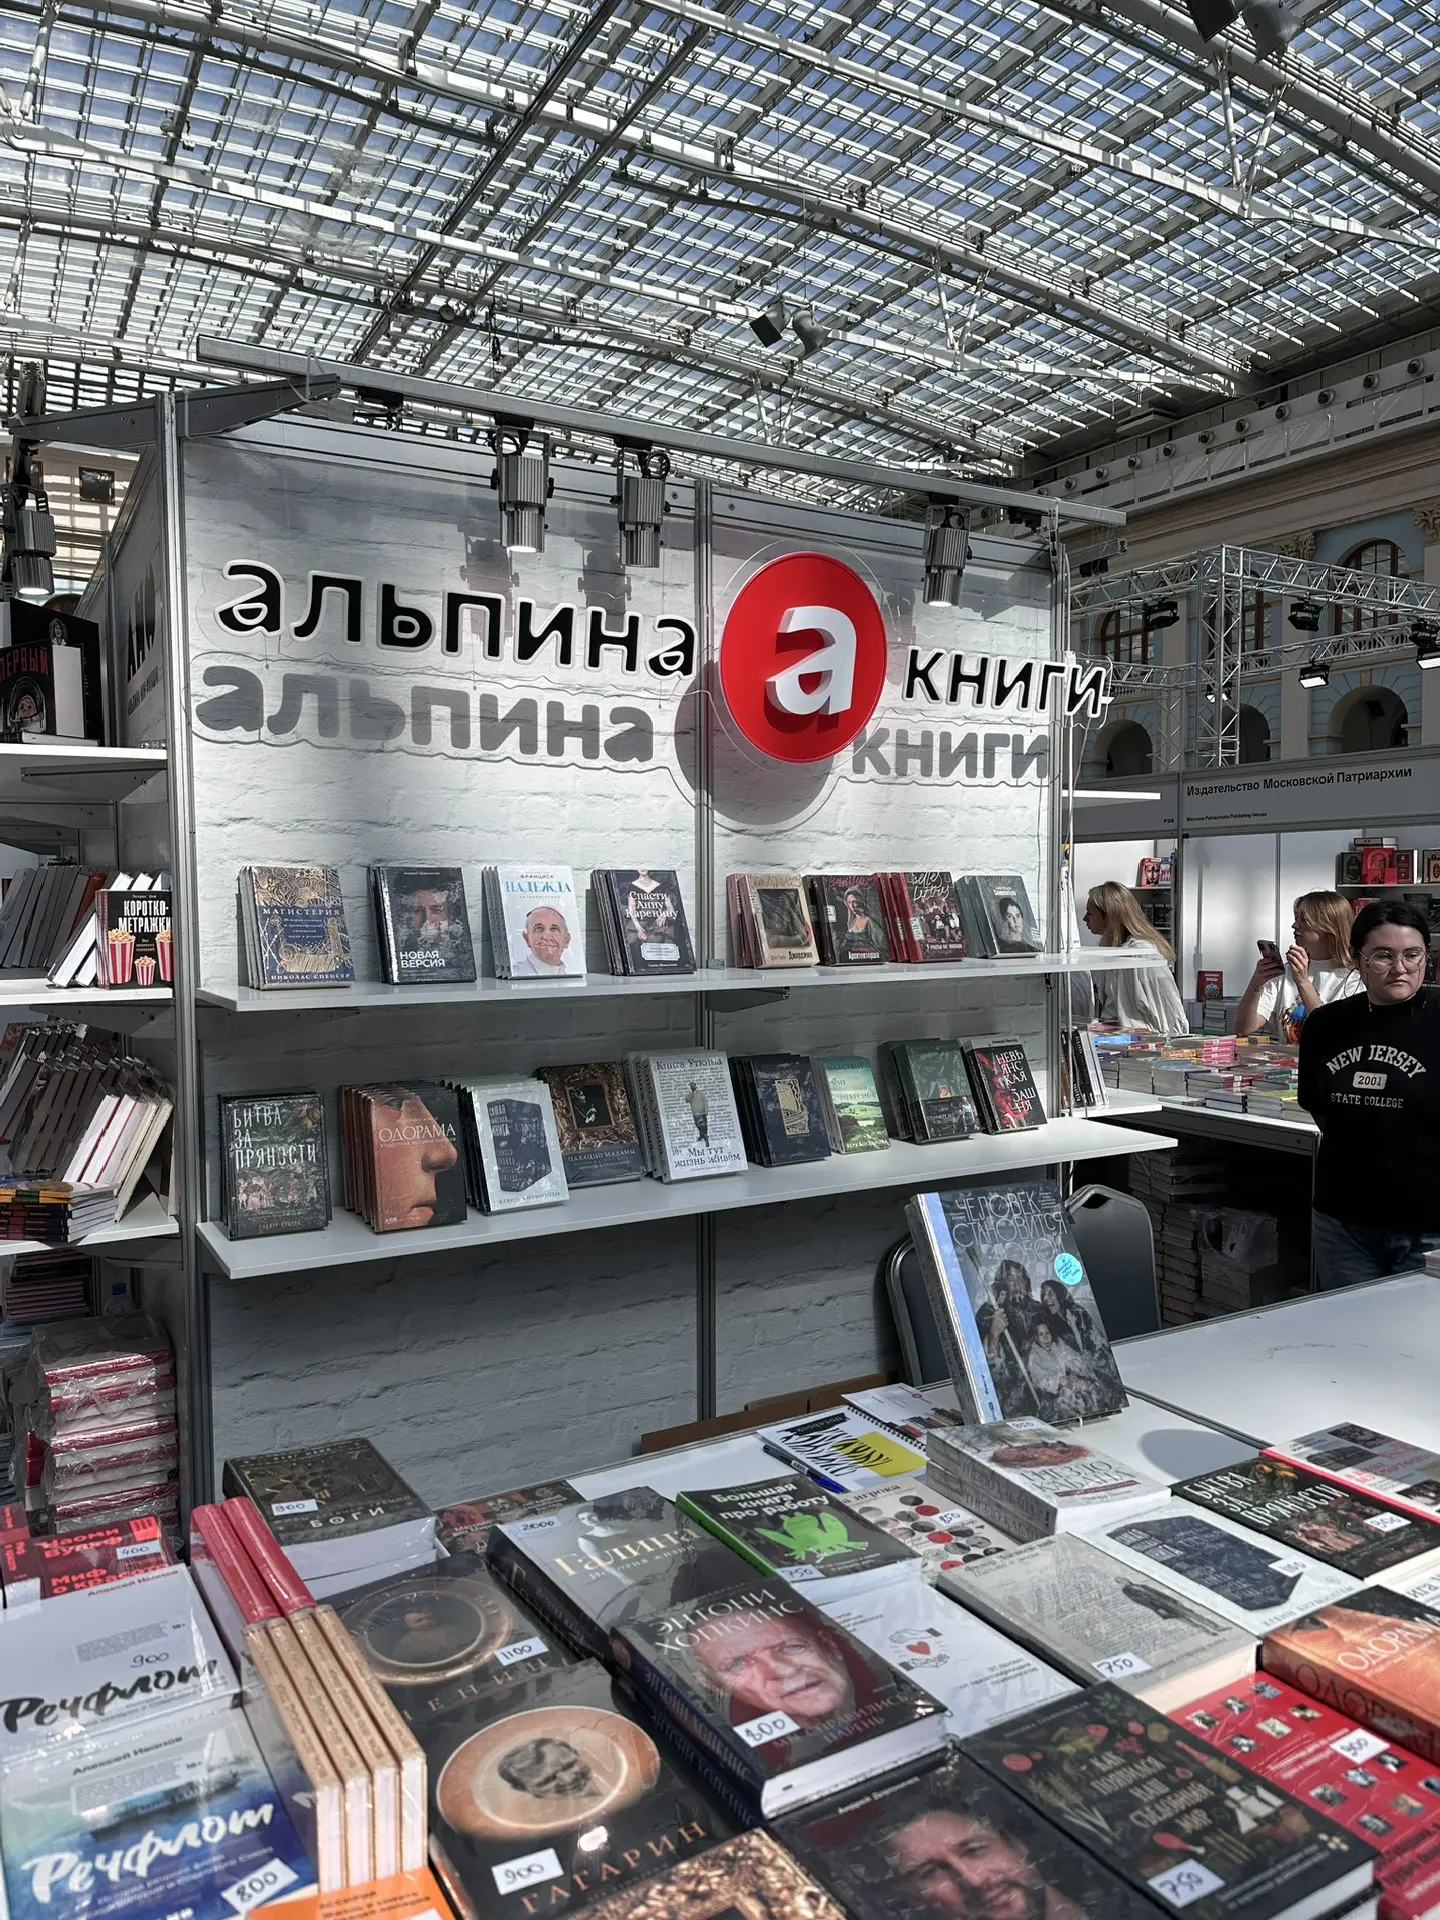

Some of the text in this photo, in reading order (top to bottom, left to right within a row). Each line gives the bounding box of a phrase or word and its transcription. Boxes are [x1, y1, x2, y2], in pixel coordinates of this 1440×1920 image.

[215, 560, 698, 680] альпина
[0, 647, 48, 683] ПЕРВЫЙ
[904, 645, 1111, 718] книги
[1187, 767, 1412, 797] Издательство Московской Патриархии
[504, 880, 572, 894] НАДЕЖДА
[629, 891, 668, 901] Спасти
[123, 900, 169, 916] КОРОТКО-
[262, 908, 341, 916] МАГИСТЕРИЯ
[625, 909, 679, 920] Каренину
[636, 900, 665, 911] Анну
[118, 916, 171, 933] МЕТРАЖКИ
[400, 951, 440, 960] НОВАЯ
[401, 959, 446, 969] ВЕРСИЯ
[656, 1058, 723, 1071] Книга Уткина
[995, 1050, 1024, 1065] НЕВЬ
[1000, 1061, 1024, 1074] ЯНС
[1326, 1045, 1427, 1078] NEW JERSEY
[1004, 1071, 1027, 1086] КАЯ
[1358, 1076, 1382, 1086] 2001
[1331, 1093, 1404, 1108] STATE COLLEGE
[233, 1104, 282, 1129] БИТВА
[234, 1128, 253, 1150] ЗА
[379, 1123, 456, 1143] ОДОРАМА
[235, 1143, 317, 1170] ПРЯНОСТИ
[605, 1149, 636, 1158] МАДАМЫ
[674, 1152, 741, 1168] жизнь живём
[687, 1146, 724, 1158] Мы тут
[955, 1190, 1041, 1222] ЧЕЛОВЕК
[952, 1211, 1067, 1248] СТАНОВИТСЯ
[1020, 1460, 1113, 1482] ГНЕЗДО
[1032, 1468, 1136, 1492] КАБАНА
[711, 1482, 797, 1503] Большая
[854, 1483, 902, 1502] игрока
[1183, 1471, 1257, 1499] БИТВА
[719, 1494, 830, 1521] про работу
[740, 1492, 794, 1509] книга
[1212, 1492, 1254, 1513] ЗА
[1240, 1483, 1351, 1527] ПРЯНОСТИ
[309, 1506, 385, 1528] БОГИ
[41, 1528, 120, 1550] Наоми
[121, 1546, 149, 1556] 400
[552, 1528, 703, 1578] Галина
[51, 1567, 107, 1587] Миф
[52, 1585, 68, 1595] о
[655, 1588, 777, 1637] ЭНТОНИ
[654, 1598, 805, 1656] ХОПКИНС
[129, 1652, 170, 1668] 900
[500, 1644, 533, 1660] 1100
[1096, 1657, 1134, 1678] 750
[132, 1734, 184, 1756] Иванов
[1089, 1751, 1126, 1774] КАК
[837, 1797, 873, 1815] Андрей
[21, 1803, 275, 1905] Речфлот
[503, 1862, 546, 1886] 900
[520, 1819, 707, 1915] ГАГАРИН
[235, 1870, 279, 1904] 800
[1158, 1871, 1204, 1902] 750
